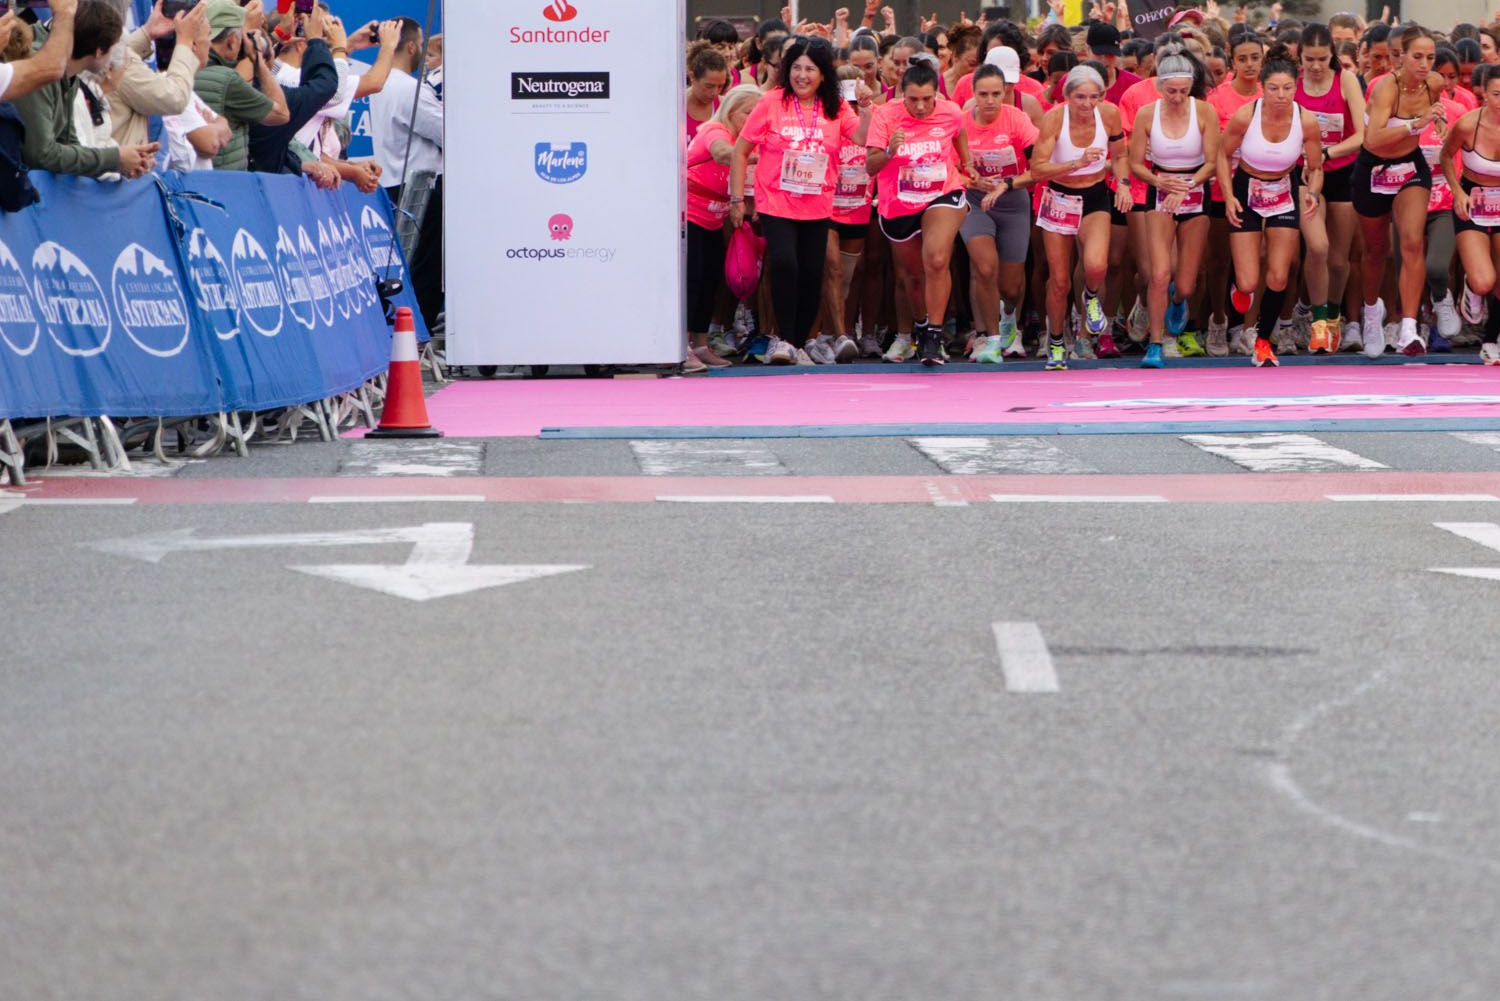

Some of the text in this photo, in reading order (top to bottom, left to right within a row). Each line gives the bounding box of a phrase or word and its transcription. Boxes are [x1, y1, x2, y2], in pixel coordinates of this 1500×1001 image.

[510, 26, 611, 44] Santander
[517, 77, 604, 97] Neutrogena
[897, 140, 942, 157] CARRERA
[506, 247, 565, 262] octopus
